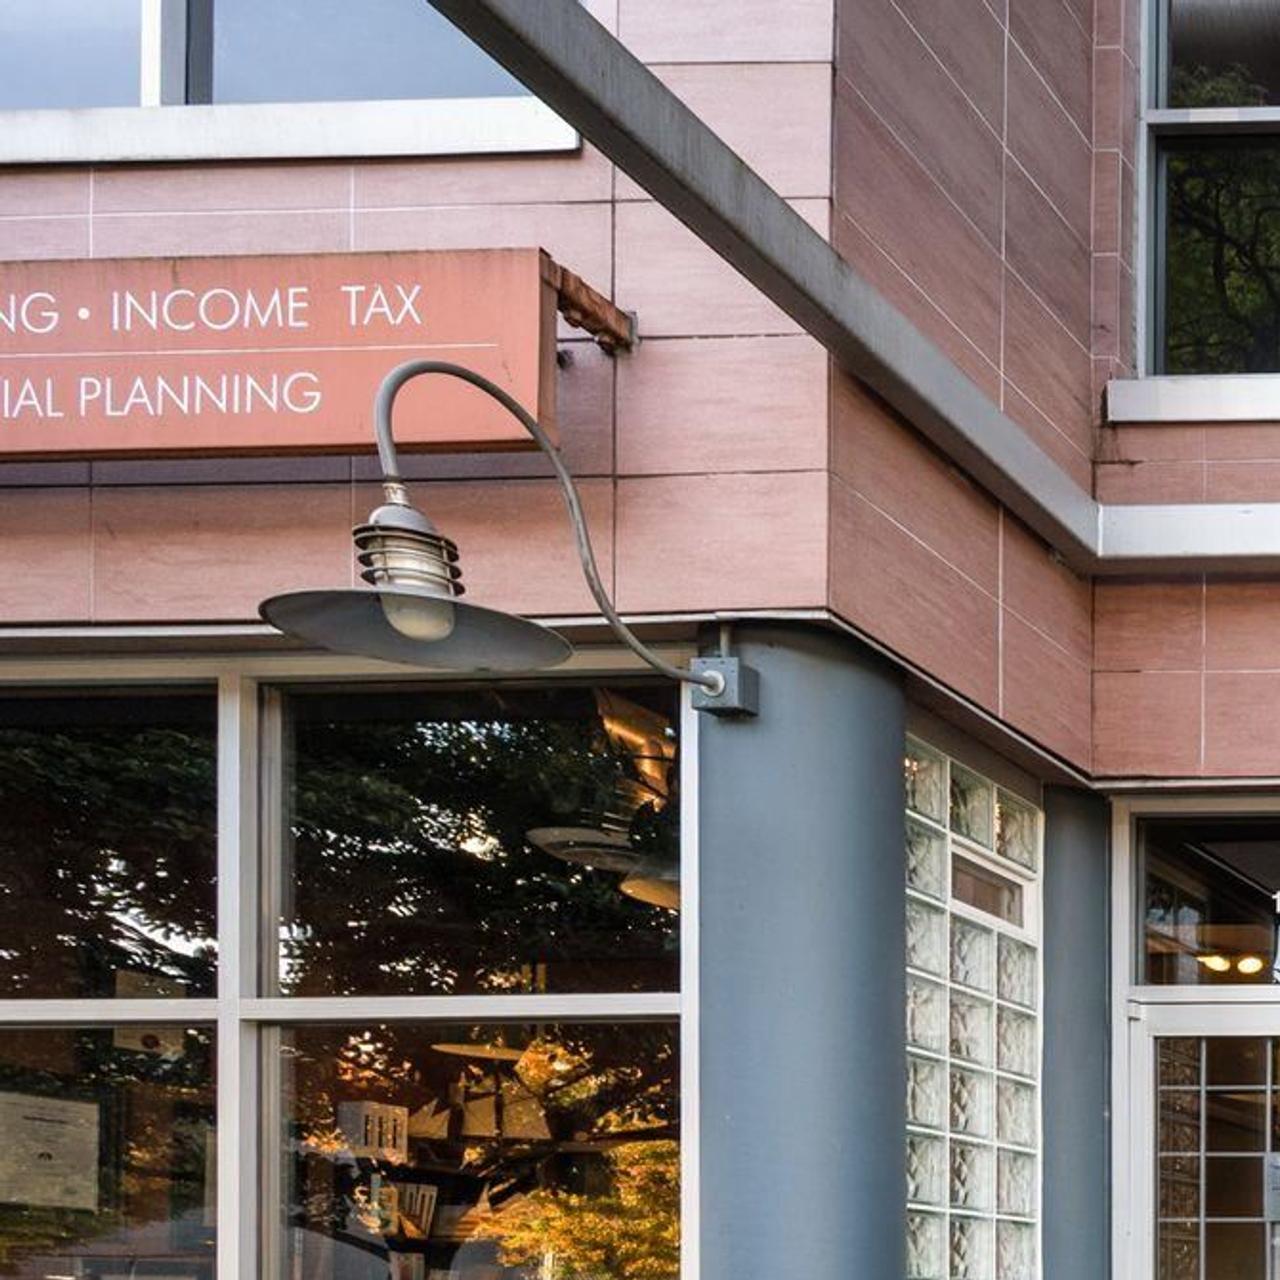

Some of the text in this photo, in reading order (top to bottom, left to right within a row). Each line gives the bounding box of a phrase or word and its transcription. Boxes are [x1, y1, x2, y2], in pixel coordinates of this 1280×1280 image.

[110, 285, 310, 332] INCOME
[340, 284, 423, 328] TAX
[3, 370, 322, 418] IAL PLANNING
